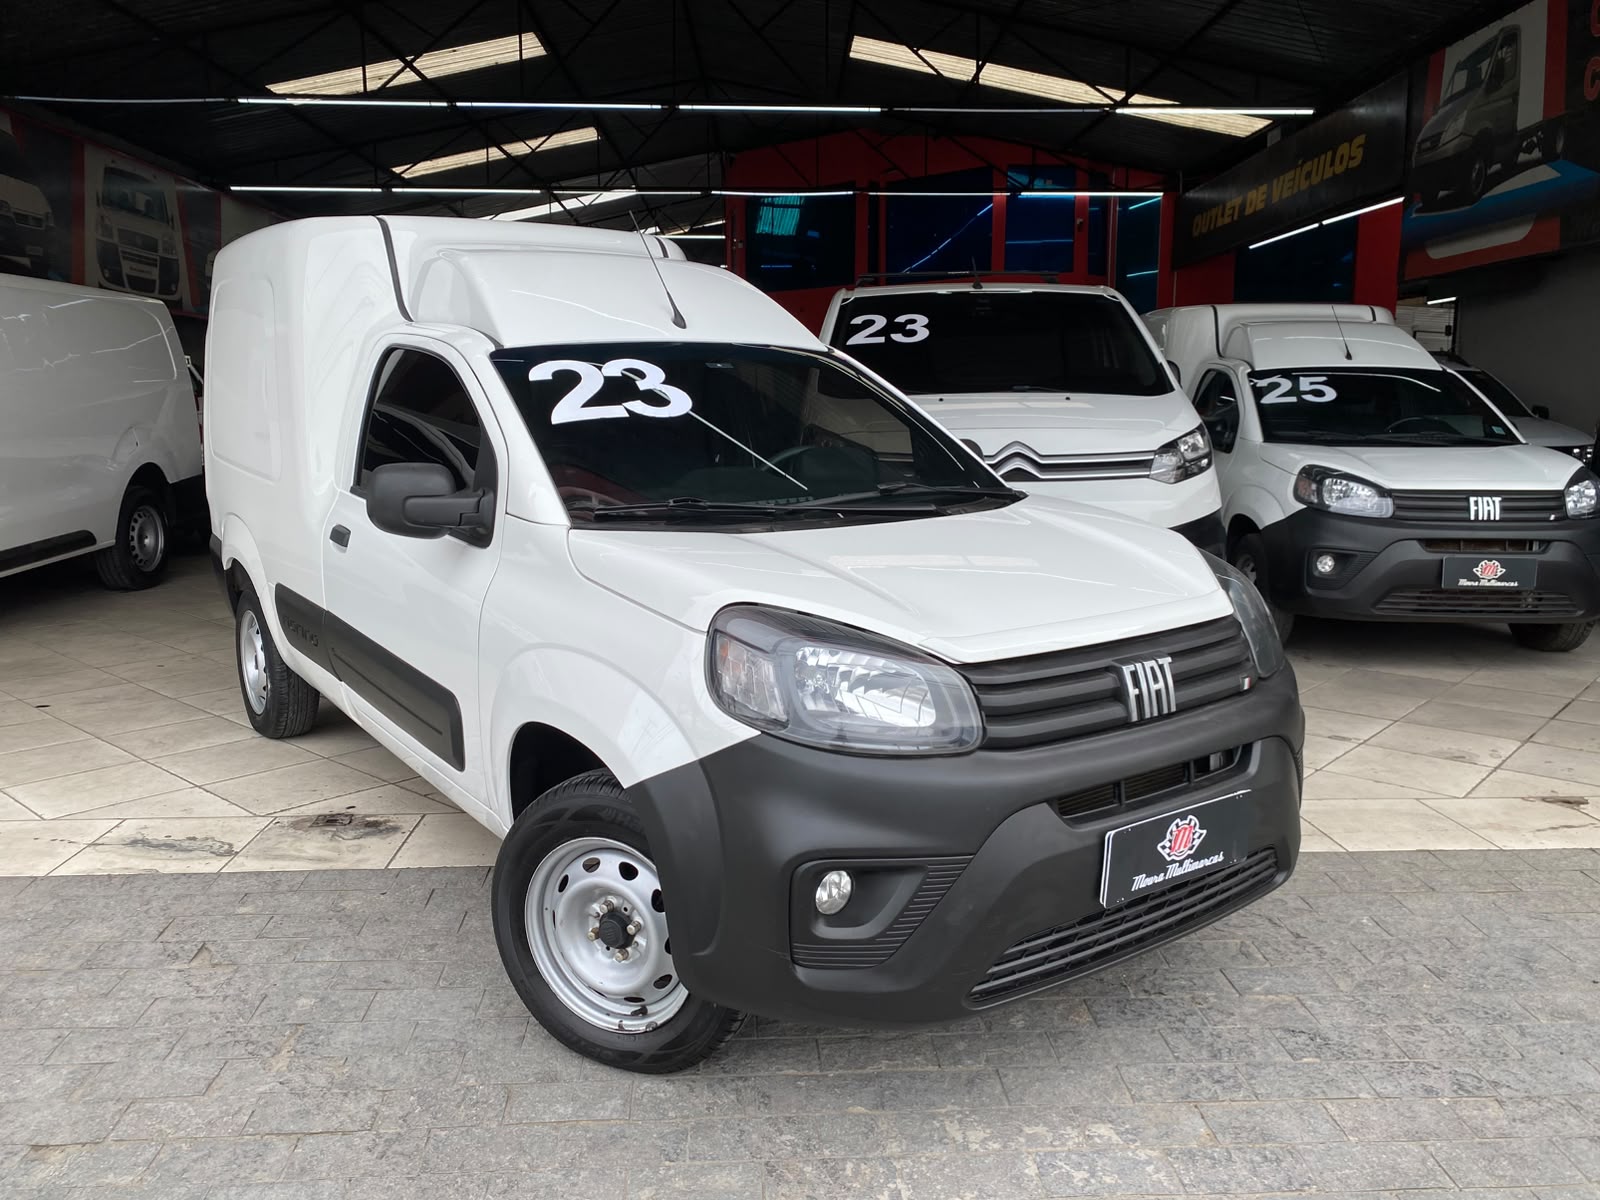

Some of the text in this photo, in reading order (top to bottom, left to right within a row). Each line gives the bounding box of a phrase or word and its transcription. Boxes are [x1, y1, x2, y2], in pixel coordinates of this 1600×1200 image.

[1192, 133, 1368, 239] OUTLET DE VEÍCULOS
[845, 313, 930, 346] 23
[528, 358, 693, 425] 23
[1256, 375, 1338, 404] 25
[1469, 496, 1502, 521] FIAT
[1122, 656, 1177, 722] FIAT
[1131, 850, 1225, 892] Moura Multimarcas
